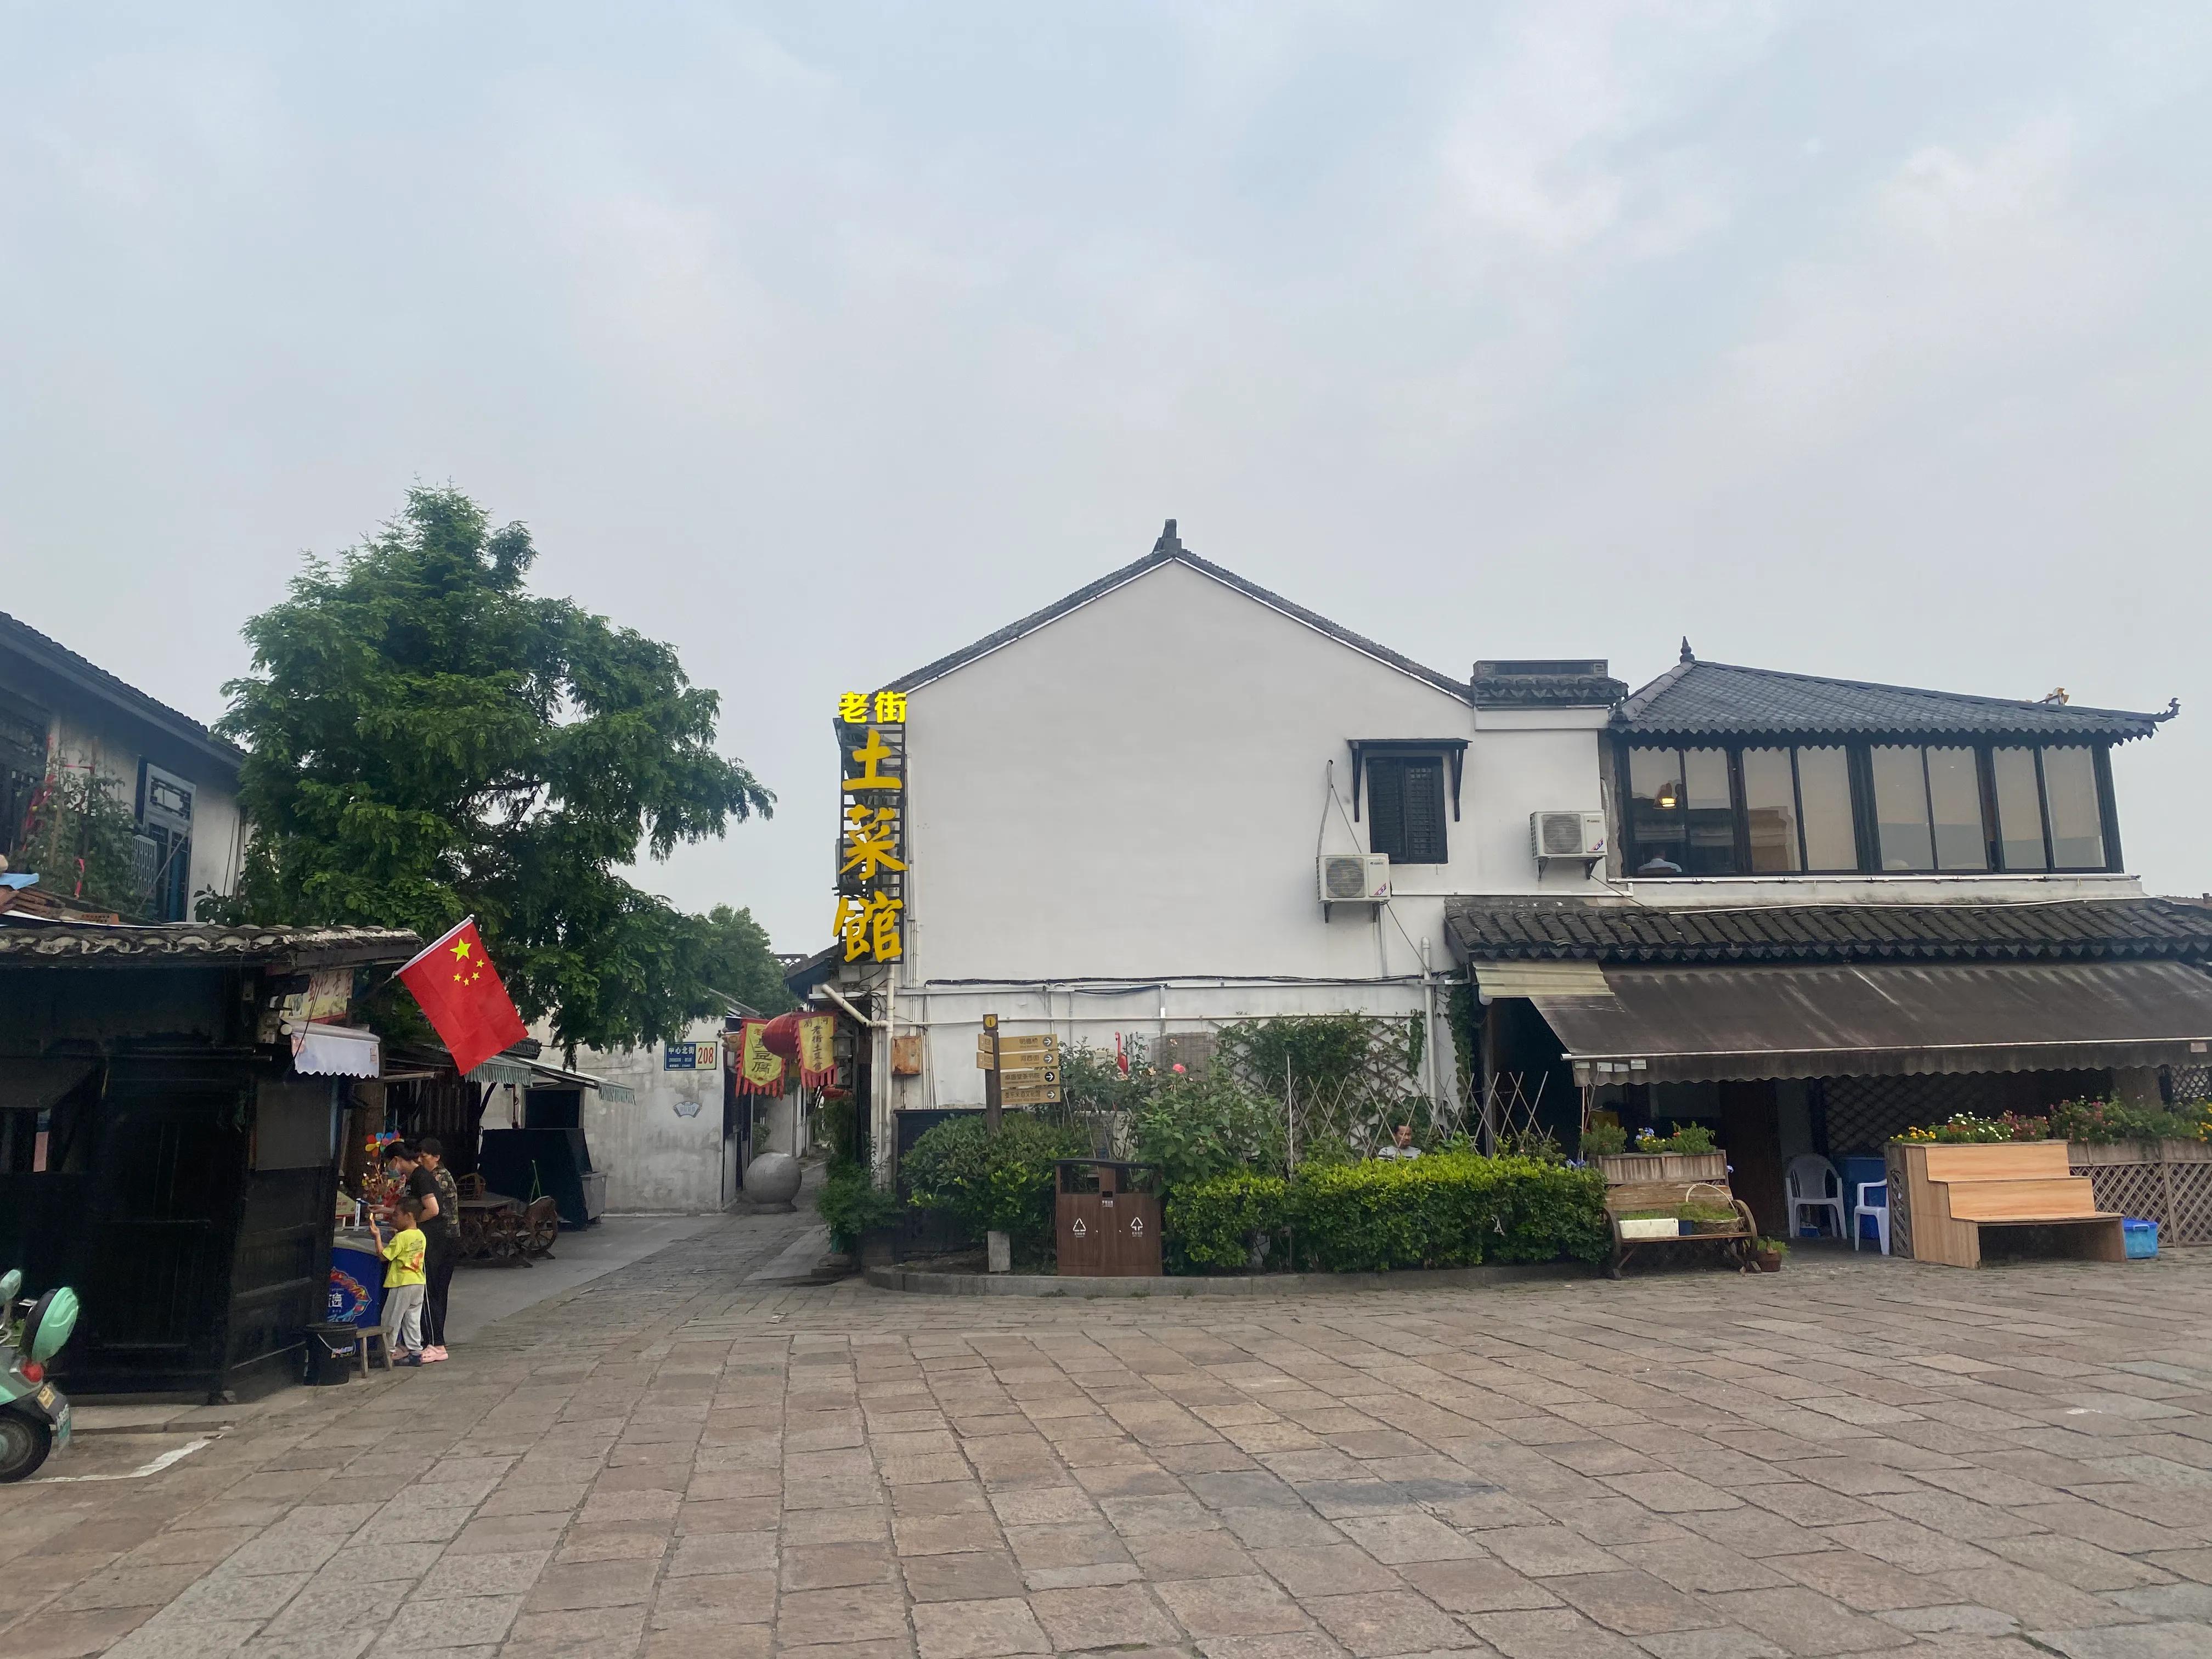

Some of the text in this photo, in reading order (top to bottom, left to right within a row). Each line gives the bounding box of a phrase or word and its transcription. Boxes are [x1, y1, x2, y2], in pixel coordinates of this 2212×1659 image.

[838, 691, 907, 723] 老街
[668, 1046, 695, 1054] 中心北街
[698, 1047, 714, 1064] 208
